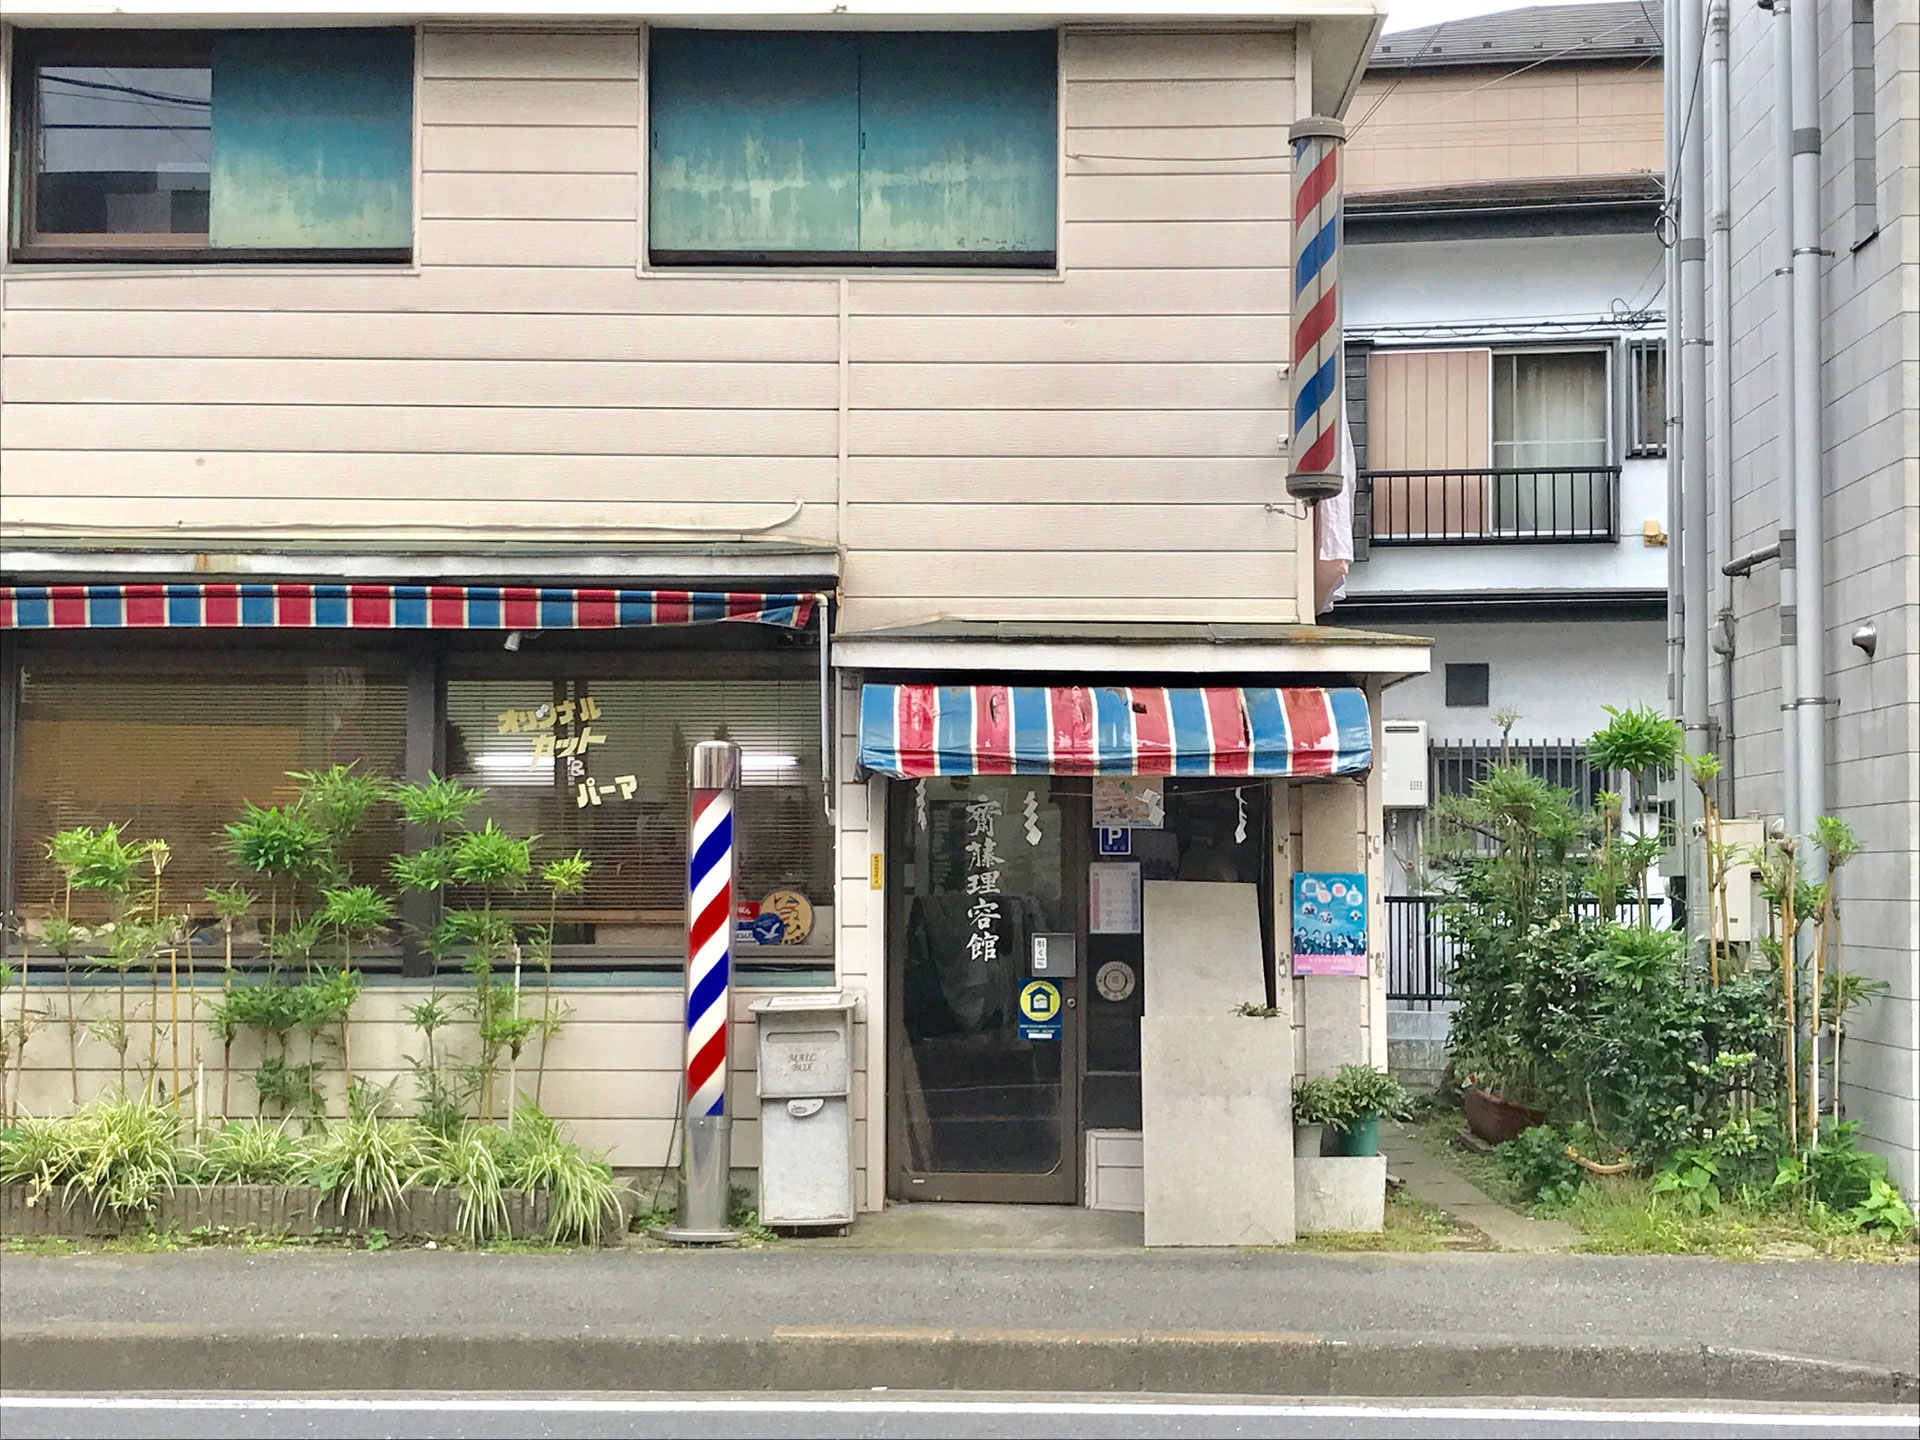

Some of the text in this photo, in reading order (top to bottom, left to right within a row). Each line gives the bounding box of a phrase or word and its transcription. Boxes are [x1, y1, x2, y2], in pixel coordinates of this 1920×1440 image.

[498, 697, 601, 734] オリジナル
[530, 727, 607, 772] カット
[570, 760, 585, 776] &
[577, 775, 637, 808] パーマ
[1108, 828, 1122, 845] P
[788, 1053, 817, 1063] MAIL
[792, 1062, 813, 1071] BOX
